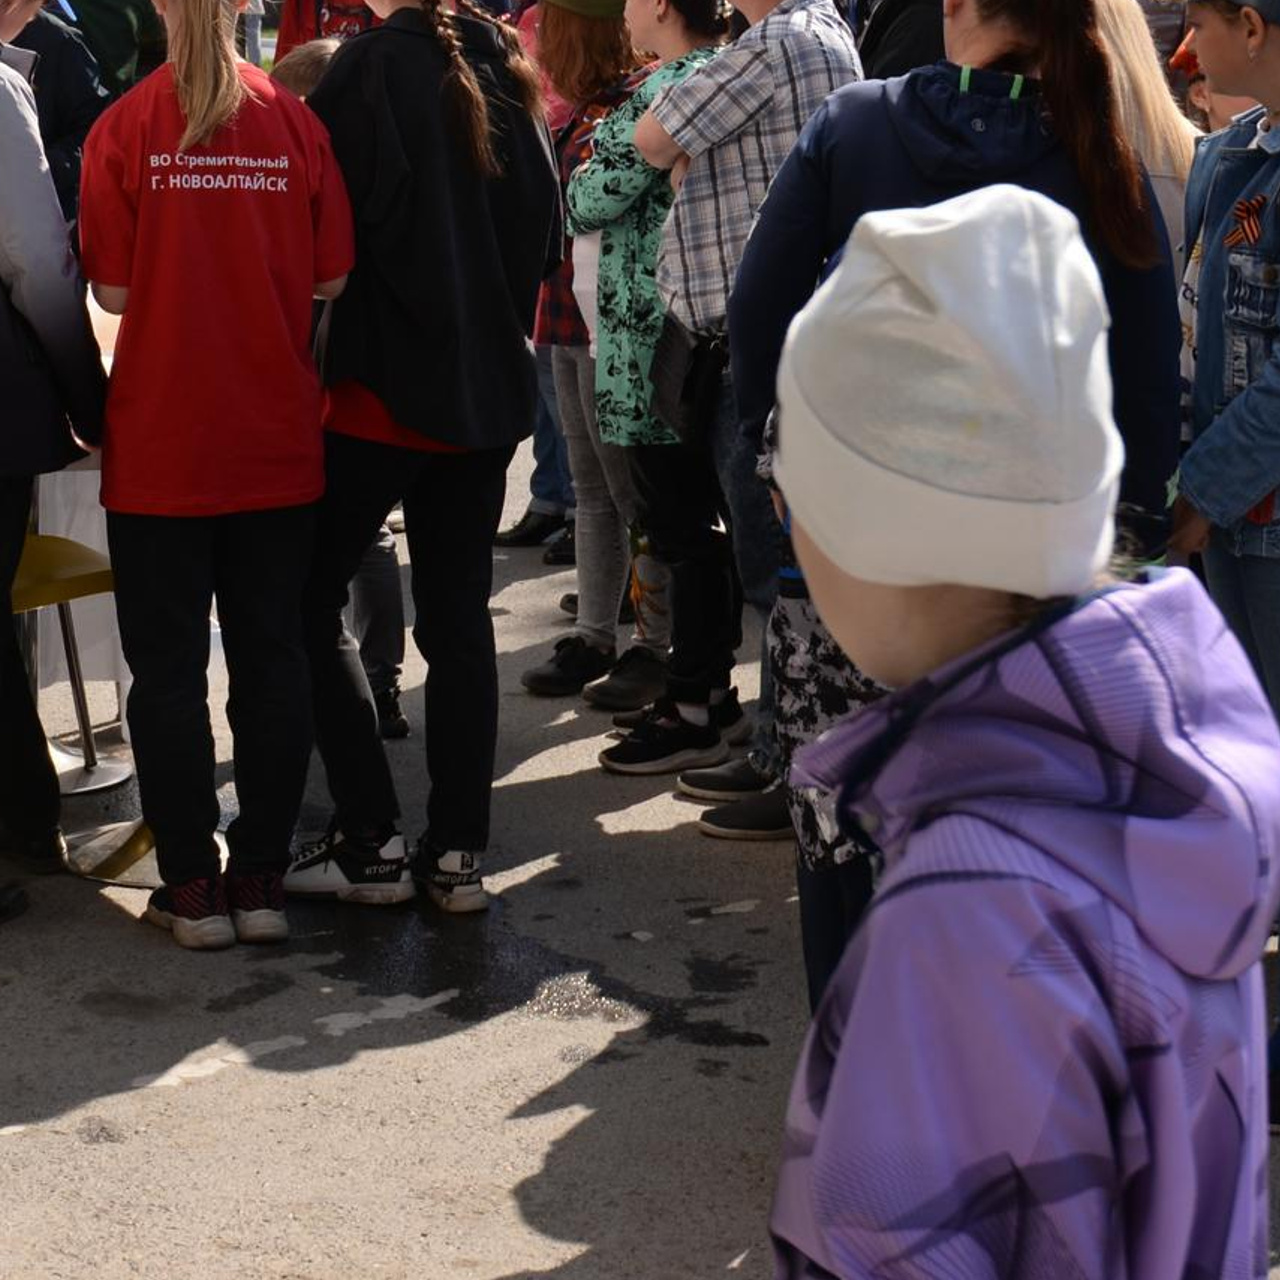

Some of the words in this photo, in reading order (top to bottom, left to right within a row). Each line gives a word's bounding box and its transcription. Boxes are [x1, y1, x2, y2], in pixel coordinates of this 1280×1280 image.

[150, 153, 171, 167] ВО
[175, 152, 288, 169] Стремительный
[169, 172, 288, 192] НОВОАЛТАЙСК
